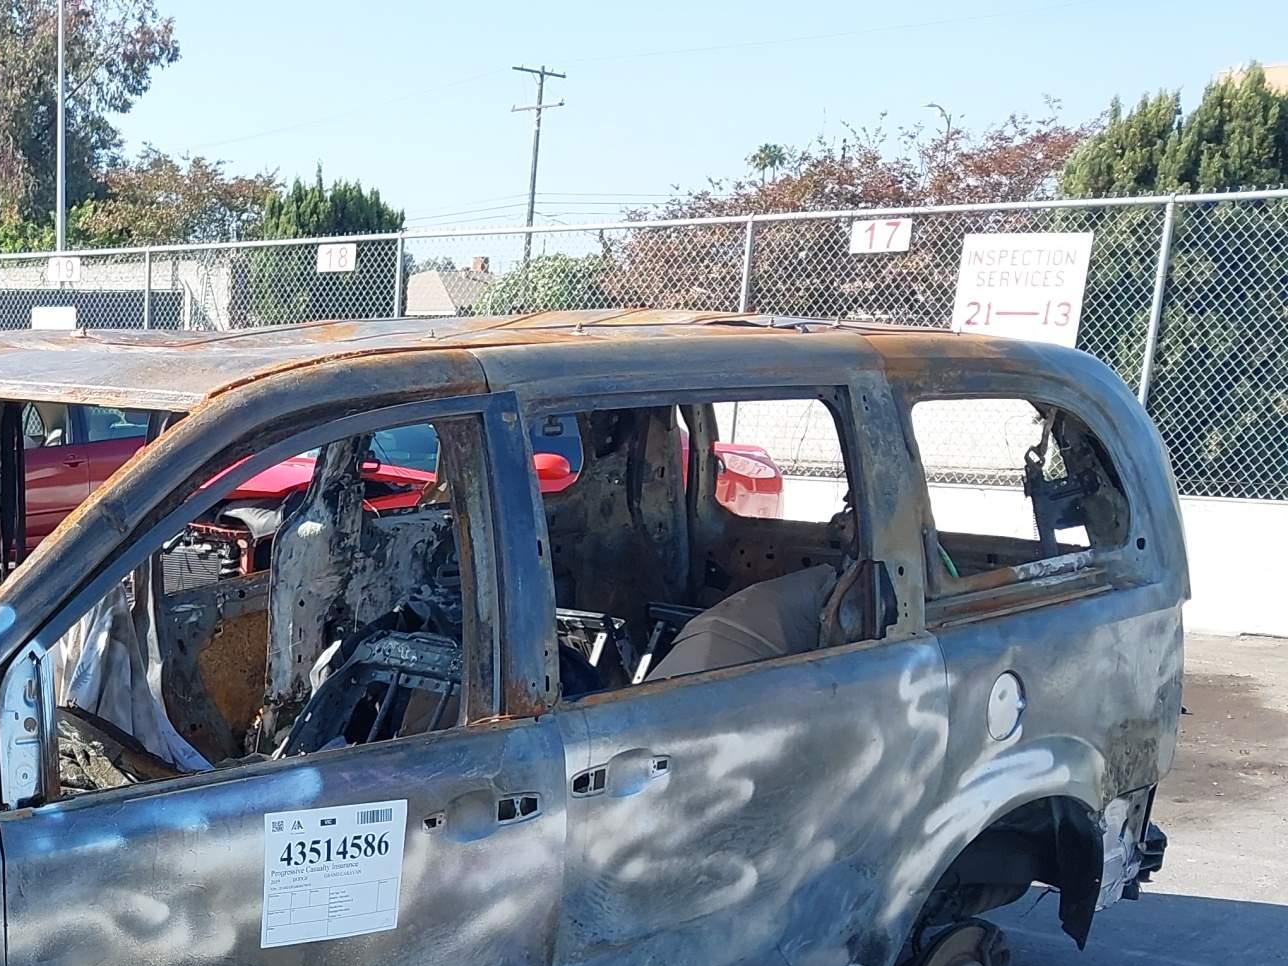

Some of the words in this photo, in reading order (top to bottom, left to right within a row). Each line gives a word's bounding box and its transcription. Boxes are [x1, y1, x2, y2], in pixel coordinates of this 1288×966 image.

[865, 221, 902, 249] 17
[326, 247, 348, 269] 18
[968, 249, 1077, 267] INSPECTION
[55, 260, 74, 279] 19
[976, 270, 1065, 288] SERVICES
[280, 831, 390, 867] 43514586
[271, 868, 305, 877] Progressive
[305, 862, 330, 873] Casualty
[331, 861, 359, 870] Insurance
